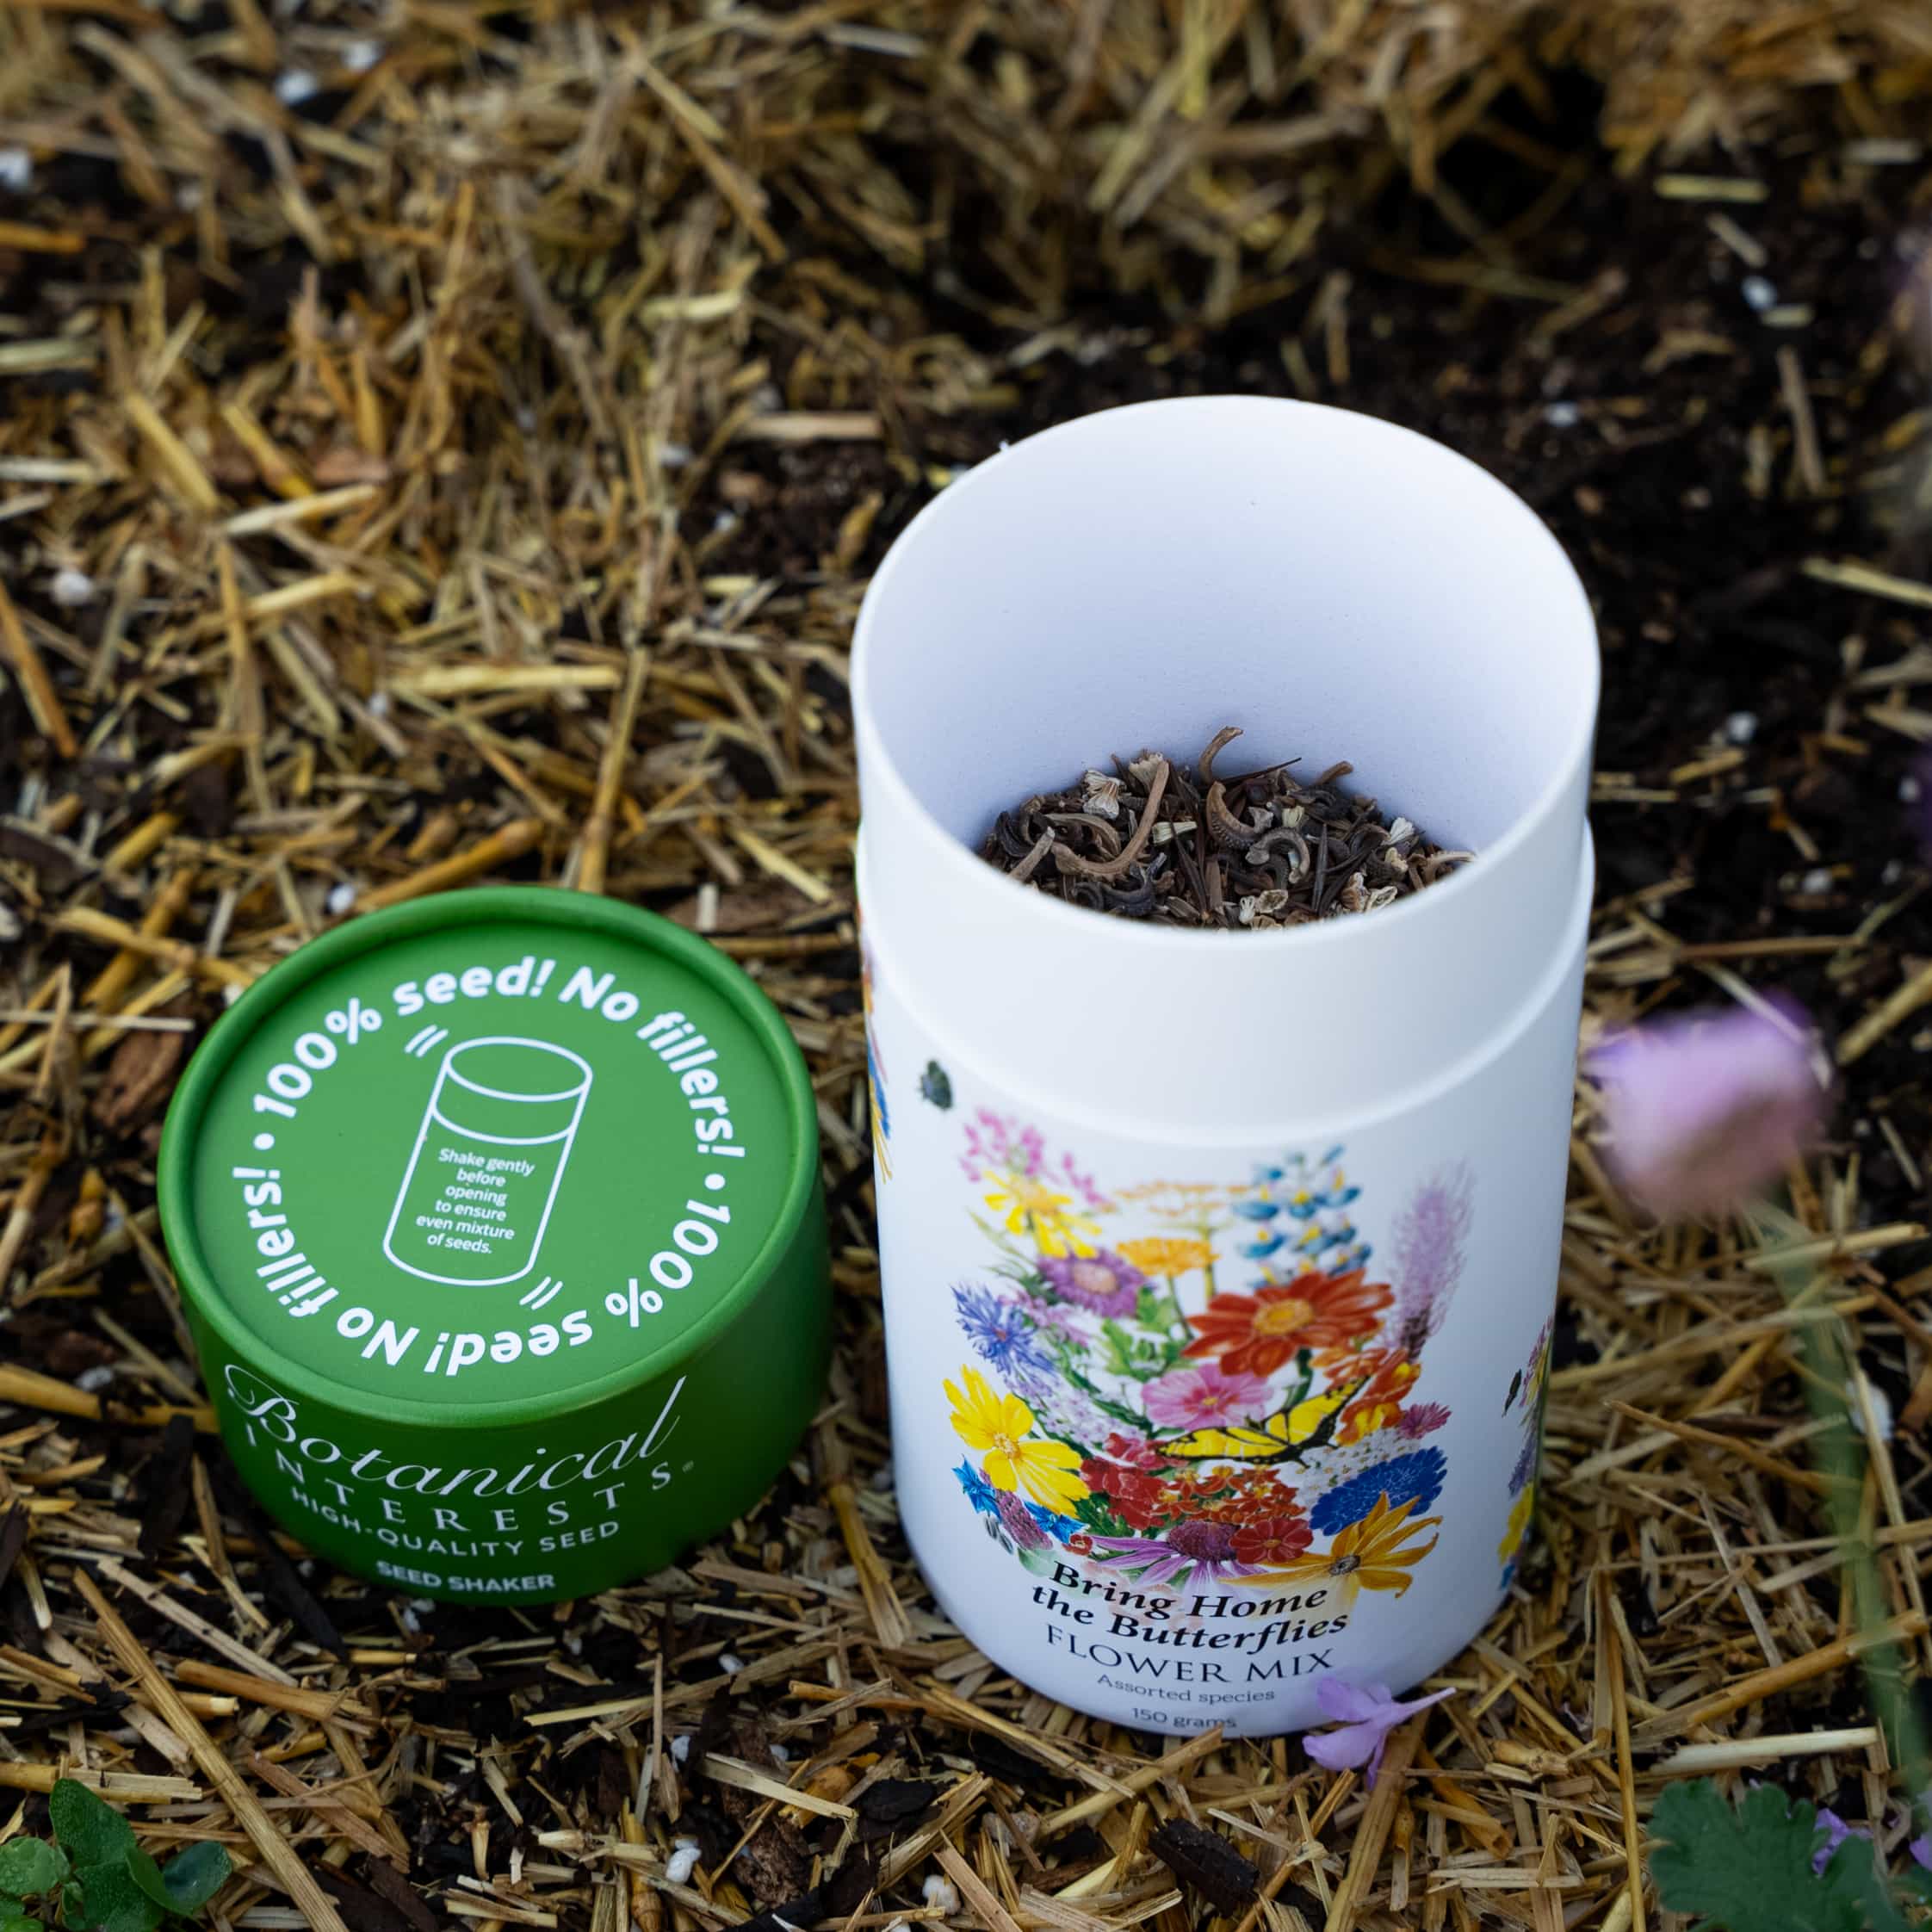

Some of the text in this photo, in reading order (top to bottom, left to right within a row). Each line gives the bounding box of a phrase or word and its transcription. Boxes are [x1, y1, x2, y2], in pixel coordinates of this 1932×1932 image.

[254, 956, 746, 1158] 100% seed! No fillers!
[438, 1148, 536, 1177] Shake gently
[456, 1167, 506, 1187] before
[435, 1199, 507, 1222] to ensure
[445, 1186, 507, 1207] opening
[416, 1215, 515, 1241] even mixture
[427, 1232, 492, 1254] of seeds.
[232, 1167, 731, 1376] 100% seed! No fillers!
[224, 1364, 687, 1498] Botanical
[292, 1487, 619, 1557] HIGH-QUALITY SEED
[376, 1559, 556, 1593] SEED SHAKER
[1049, 1560, 1328, 1619] Bring Home
[1032, 1584, 1348, 1655] the Butterflies
[1046, 1624, 1336, 1683] FLOWER MIX
[1097, 1674, 1275, 1705] Assorted species
[1132, 1707, 1237, 1729] 150 grams
